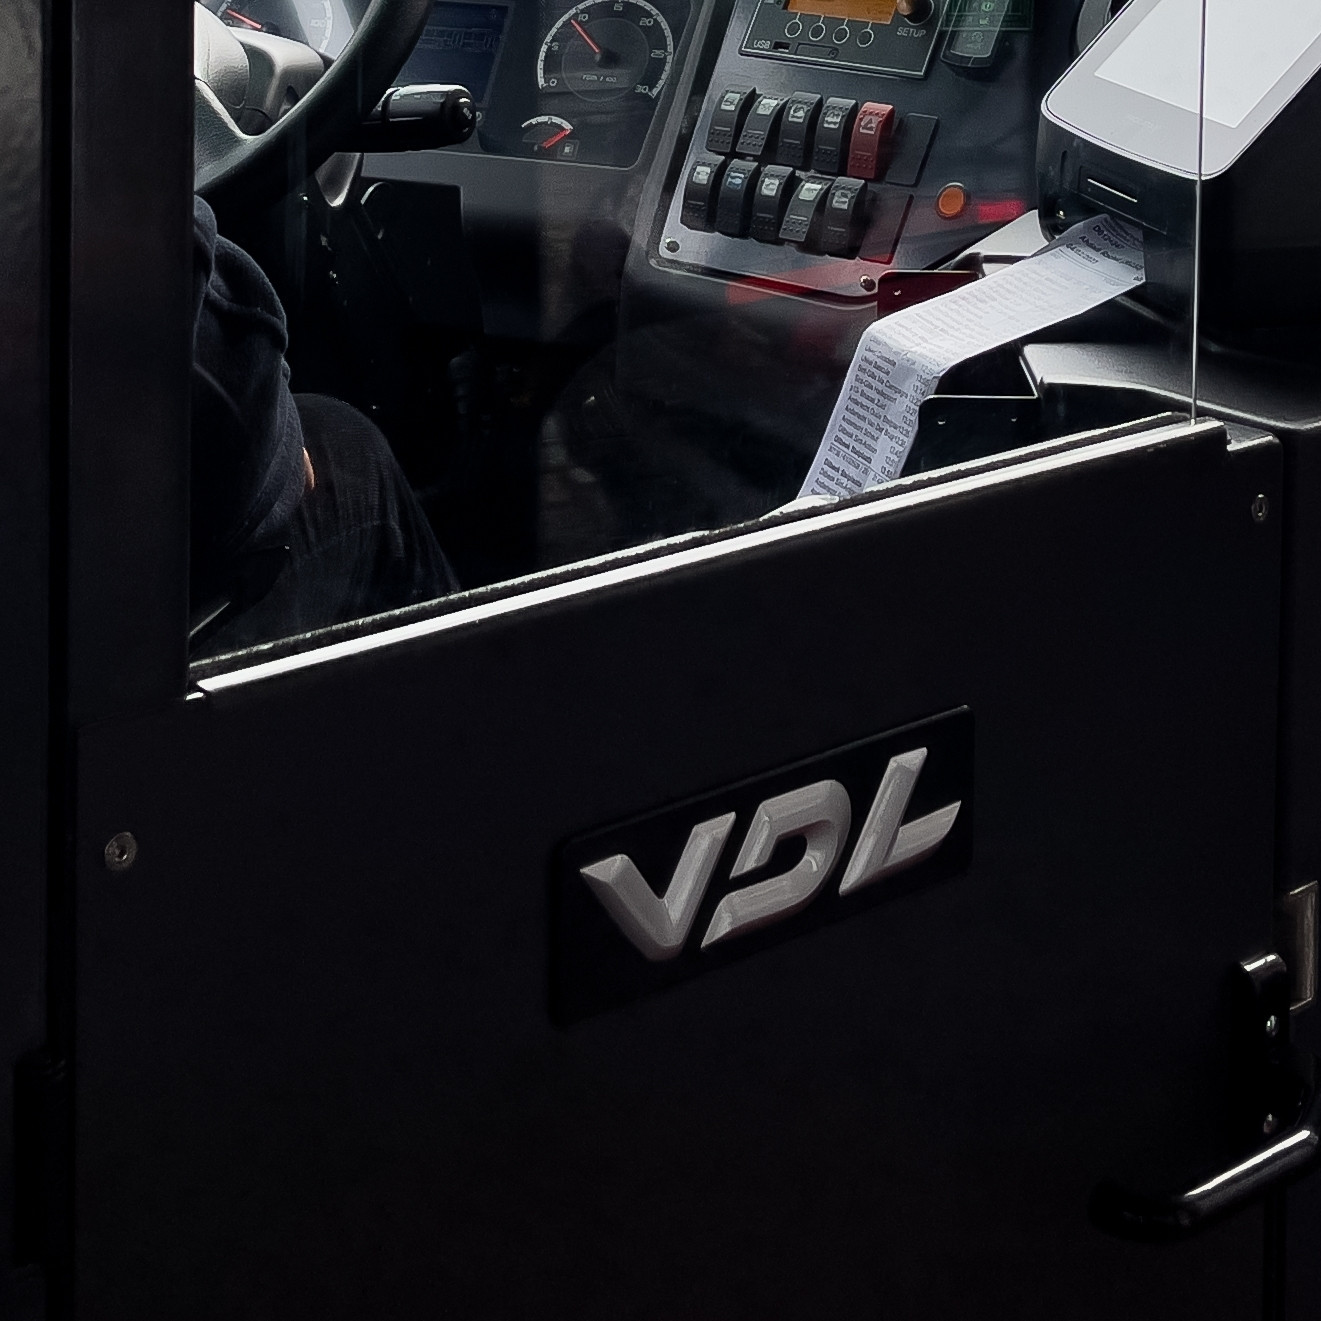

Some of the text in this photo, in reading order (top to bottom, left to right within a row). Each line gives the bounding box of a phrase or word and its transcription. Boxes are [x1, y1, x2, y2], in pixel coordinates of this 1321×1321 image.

[639, 17, 654, 26] 20
[896, 26, 927, 38] SETUP
[753, 39, 771, 49] USB
[580, 747, 961, 961] VDL
